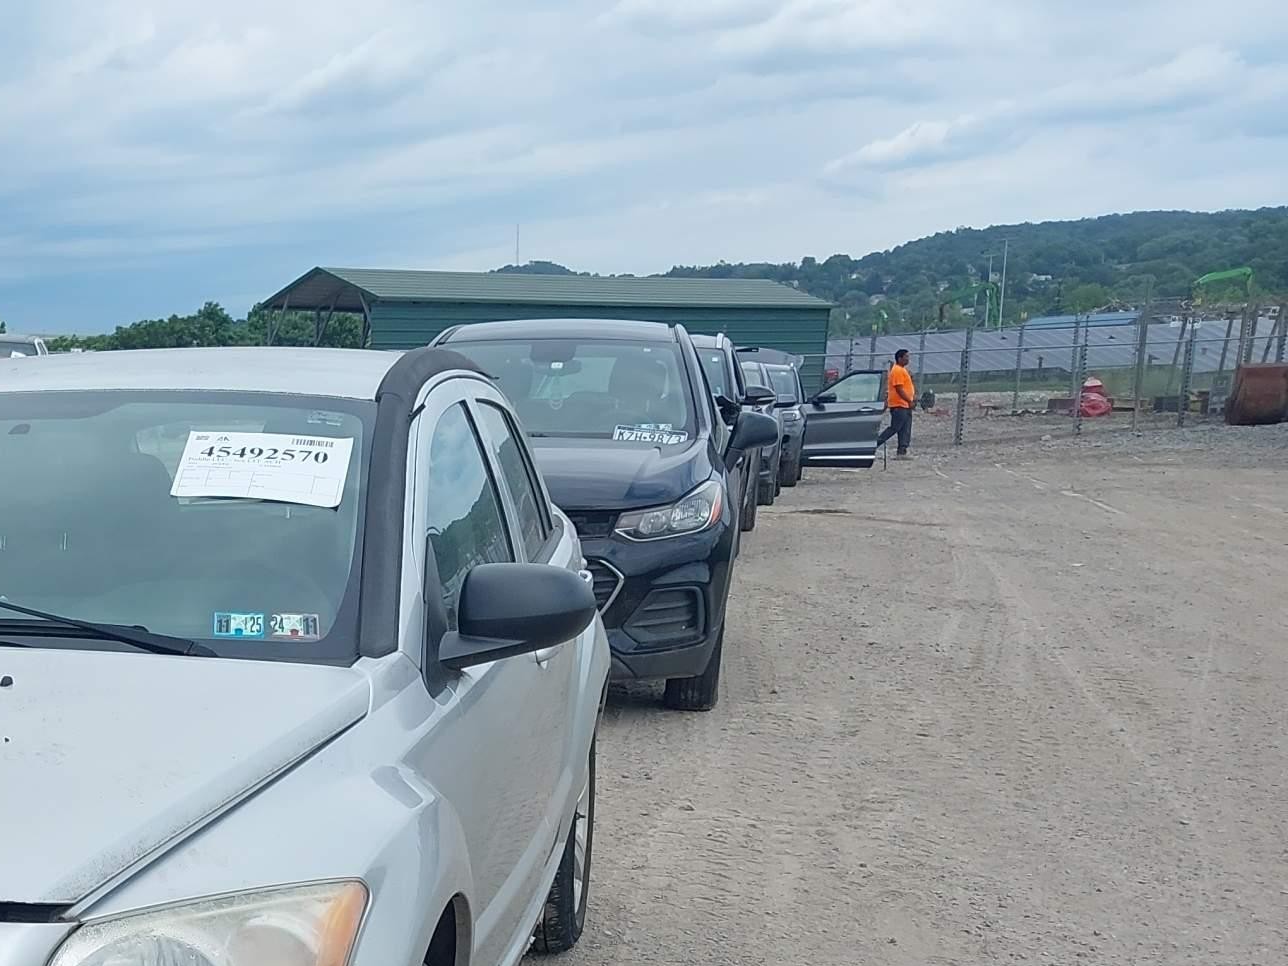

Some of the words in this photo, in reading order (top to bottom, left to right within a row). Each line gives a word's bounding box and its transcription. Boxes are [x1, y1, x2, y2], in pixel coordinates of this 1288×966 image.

[200, 445, 329, 464] 45492570
[249, 616, 263, 633] 25
[271, 616, 285, 633] 24
